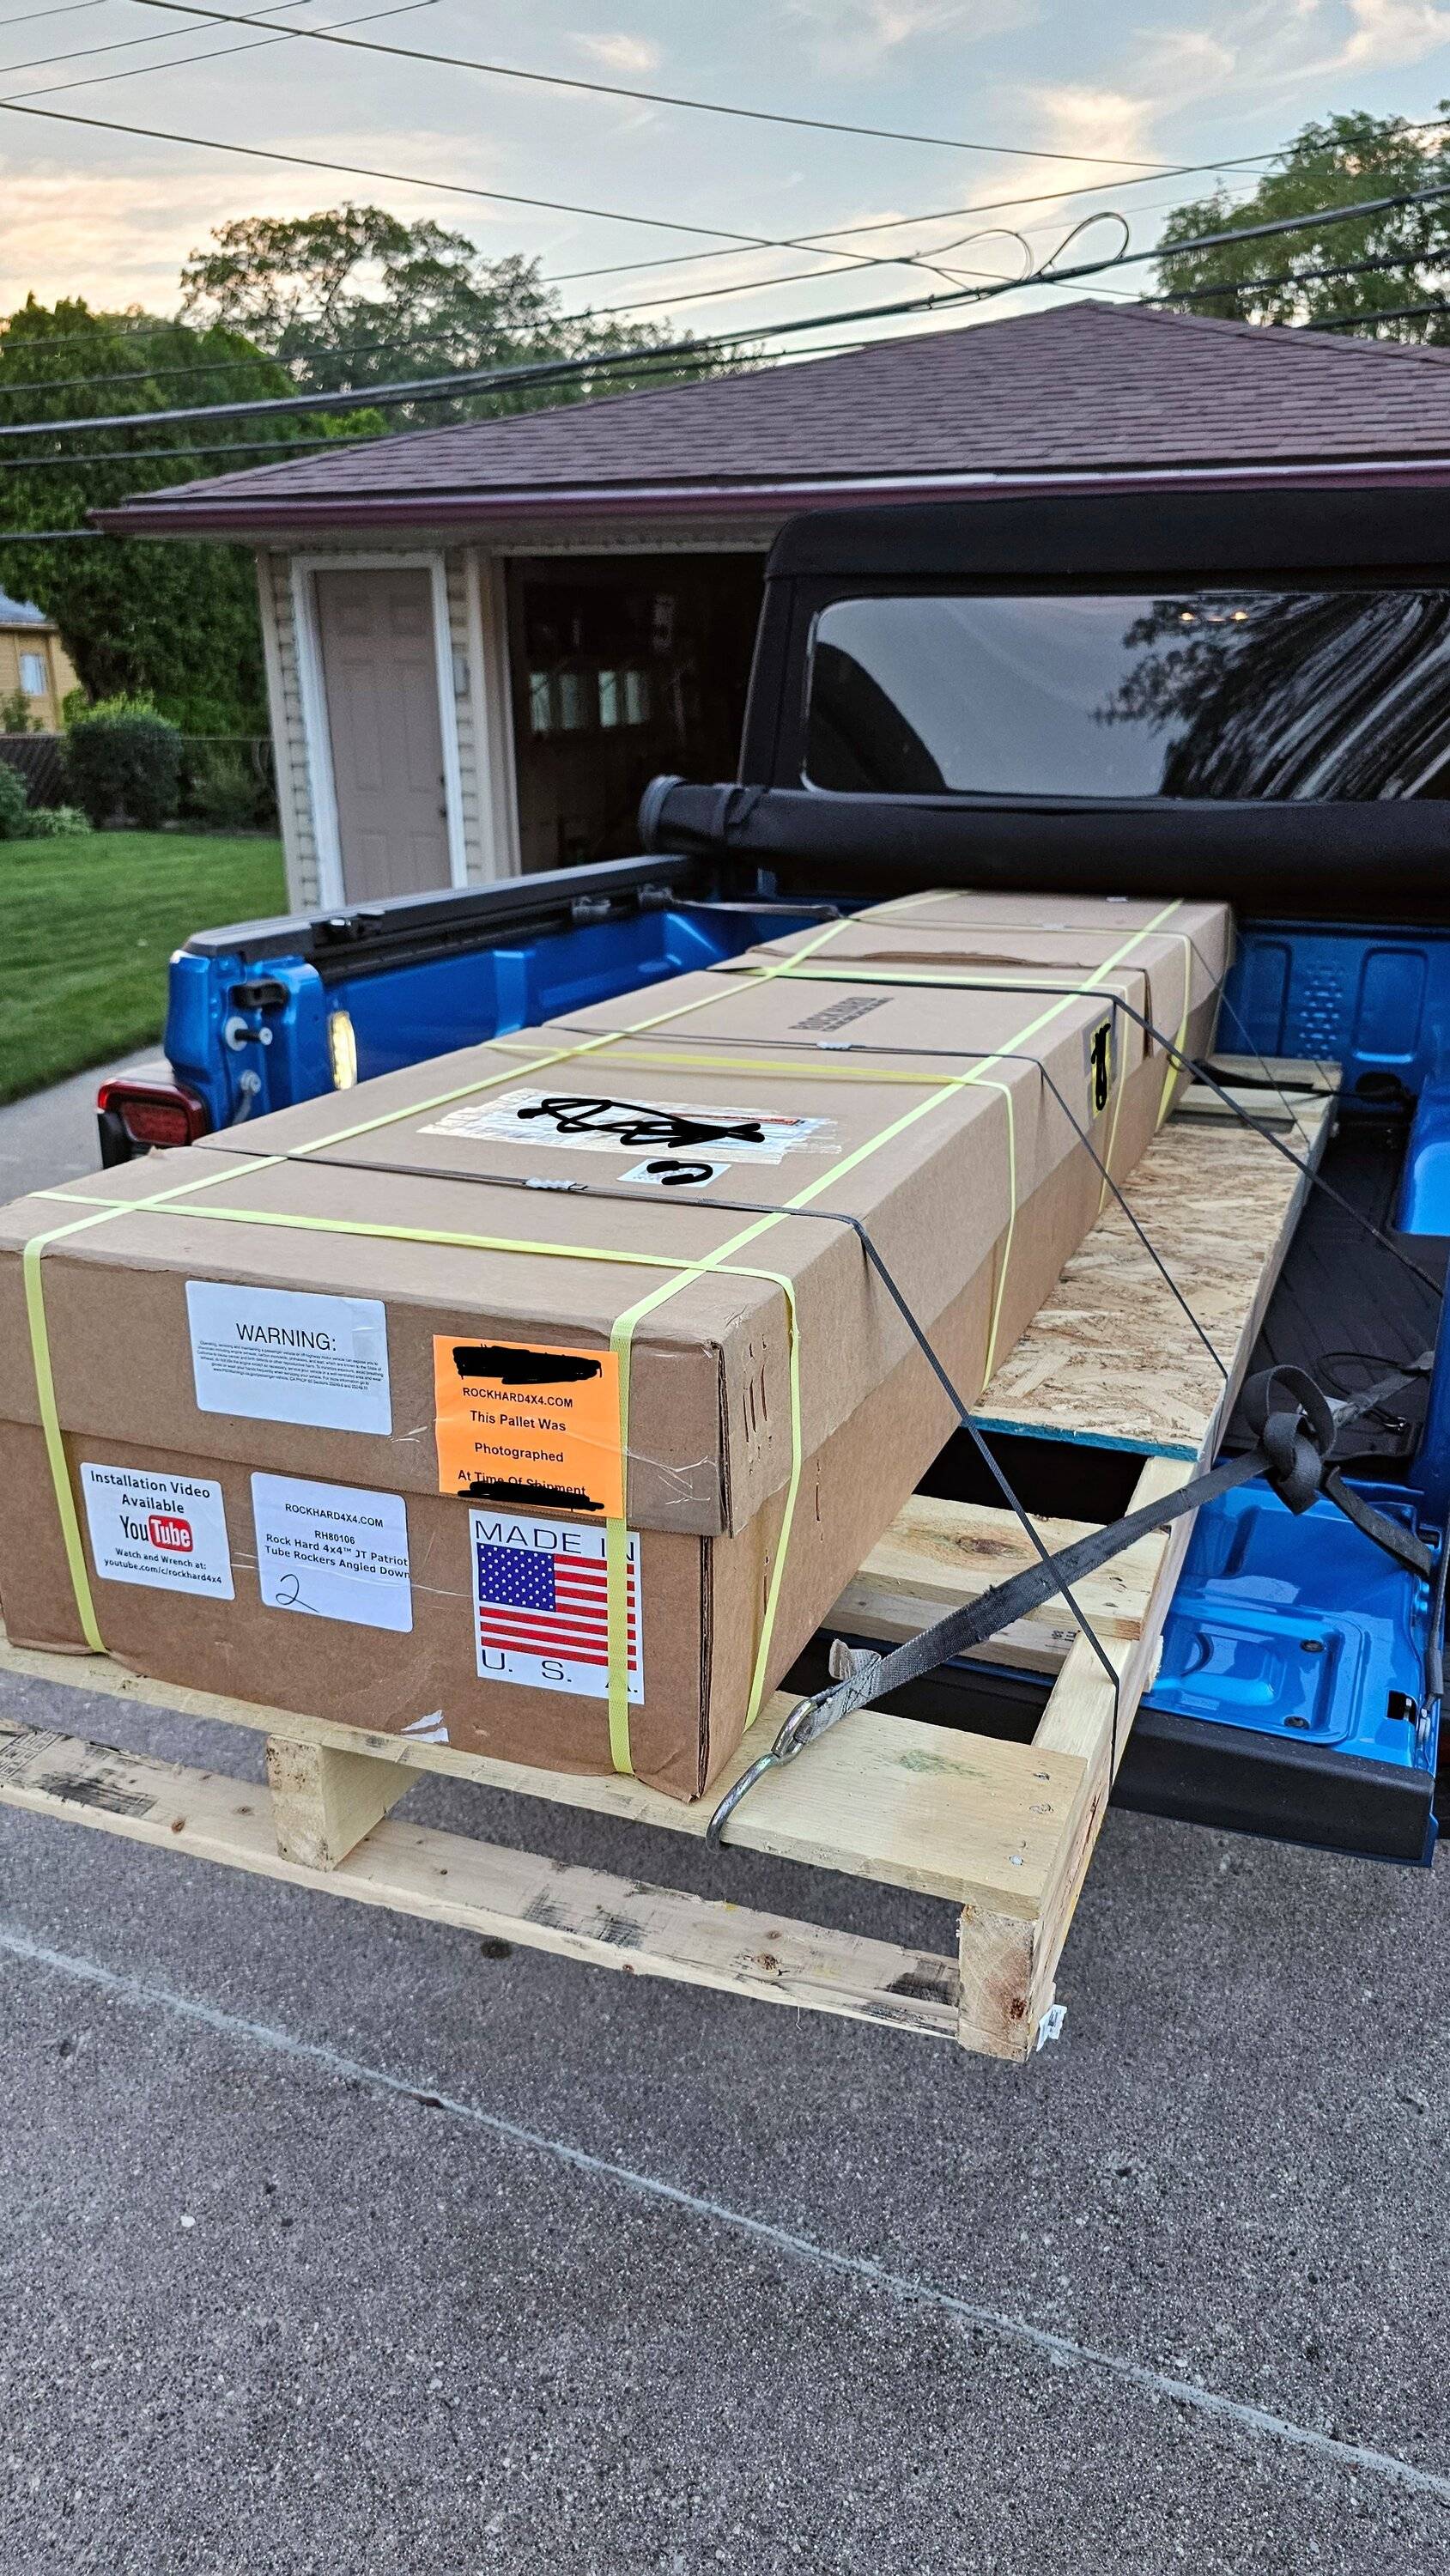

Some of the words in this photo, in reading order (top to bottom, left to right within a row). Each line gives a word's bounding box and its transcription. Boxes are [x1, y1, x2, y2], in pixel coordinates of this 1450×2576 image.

[236, 1322, 337, 1352] WARNING:
[463, 1388, 573, 1407] ROCKHARD4X4.COM
[470, 1411, 495, 1424] This
[500, 1414, 535, 1429] Pallet
[538, 1419, 566, 1431] Was
[475, 1443, 564, 1462] Photographed
[91, 1471, 167, 1492] Installation
[170, 1482, 210, 1498] Video
[458, 1470, 471, 1481] At
[474, 1472, 504, 1483] Time
[508, 1476, 523, 1485] Of
[122, 1494, 185, 1513] Available
[285, 1504, 384, 1528] ROCKHARD4X4.COM
[119, 1515, 191, 1547] YouTube
[314, 1530, 355, 1545] RH80106
[475, 1520, 582, 1554] MADE
[115, 1547, 142, 1558] Watch
[161, 1555, 193, 1568] Wrench
[264, 1545, 291, 1558] Tube
[294, 1551, 336, 1566] Rockers
[338, 1558, 376, 1571] Angled
[379, 1566, 410, 1579] Down
[266, 1534, 291, 1546] Rock
[294, 1538, 319, 1551] Hard
[355, 1550, 367, 1559] JT
[371, 1552, 409, 1567] Patriot
[104, 1558, 221, 1583] youtube.com/c/rockhard4x4
[276, 1573, 320, 1613] 2
